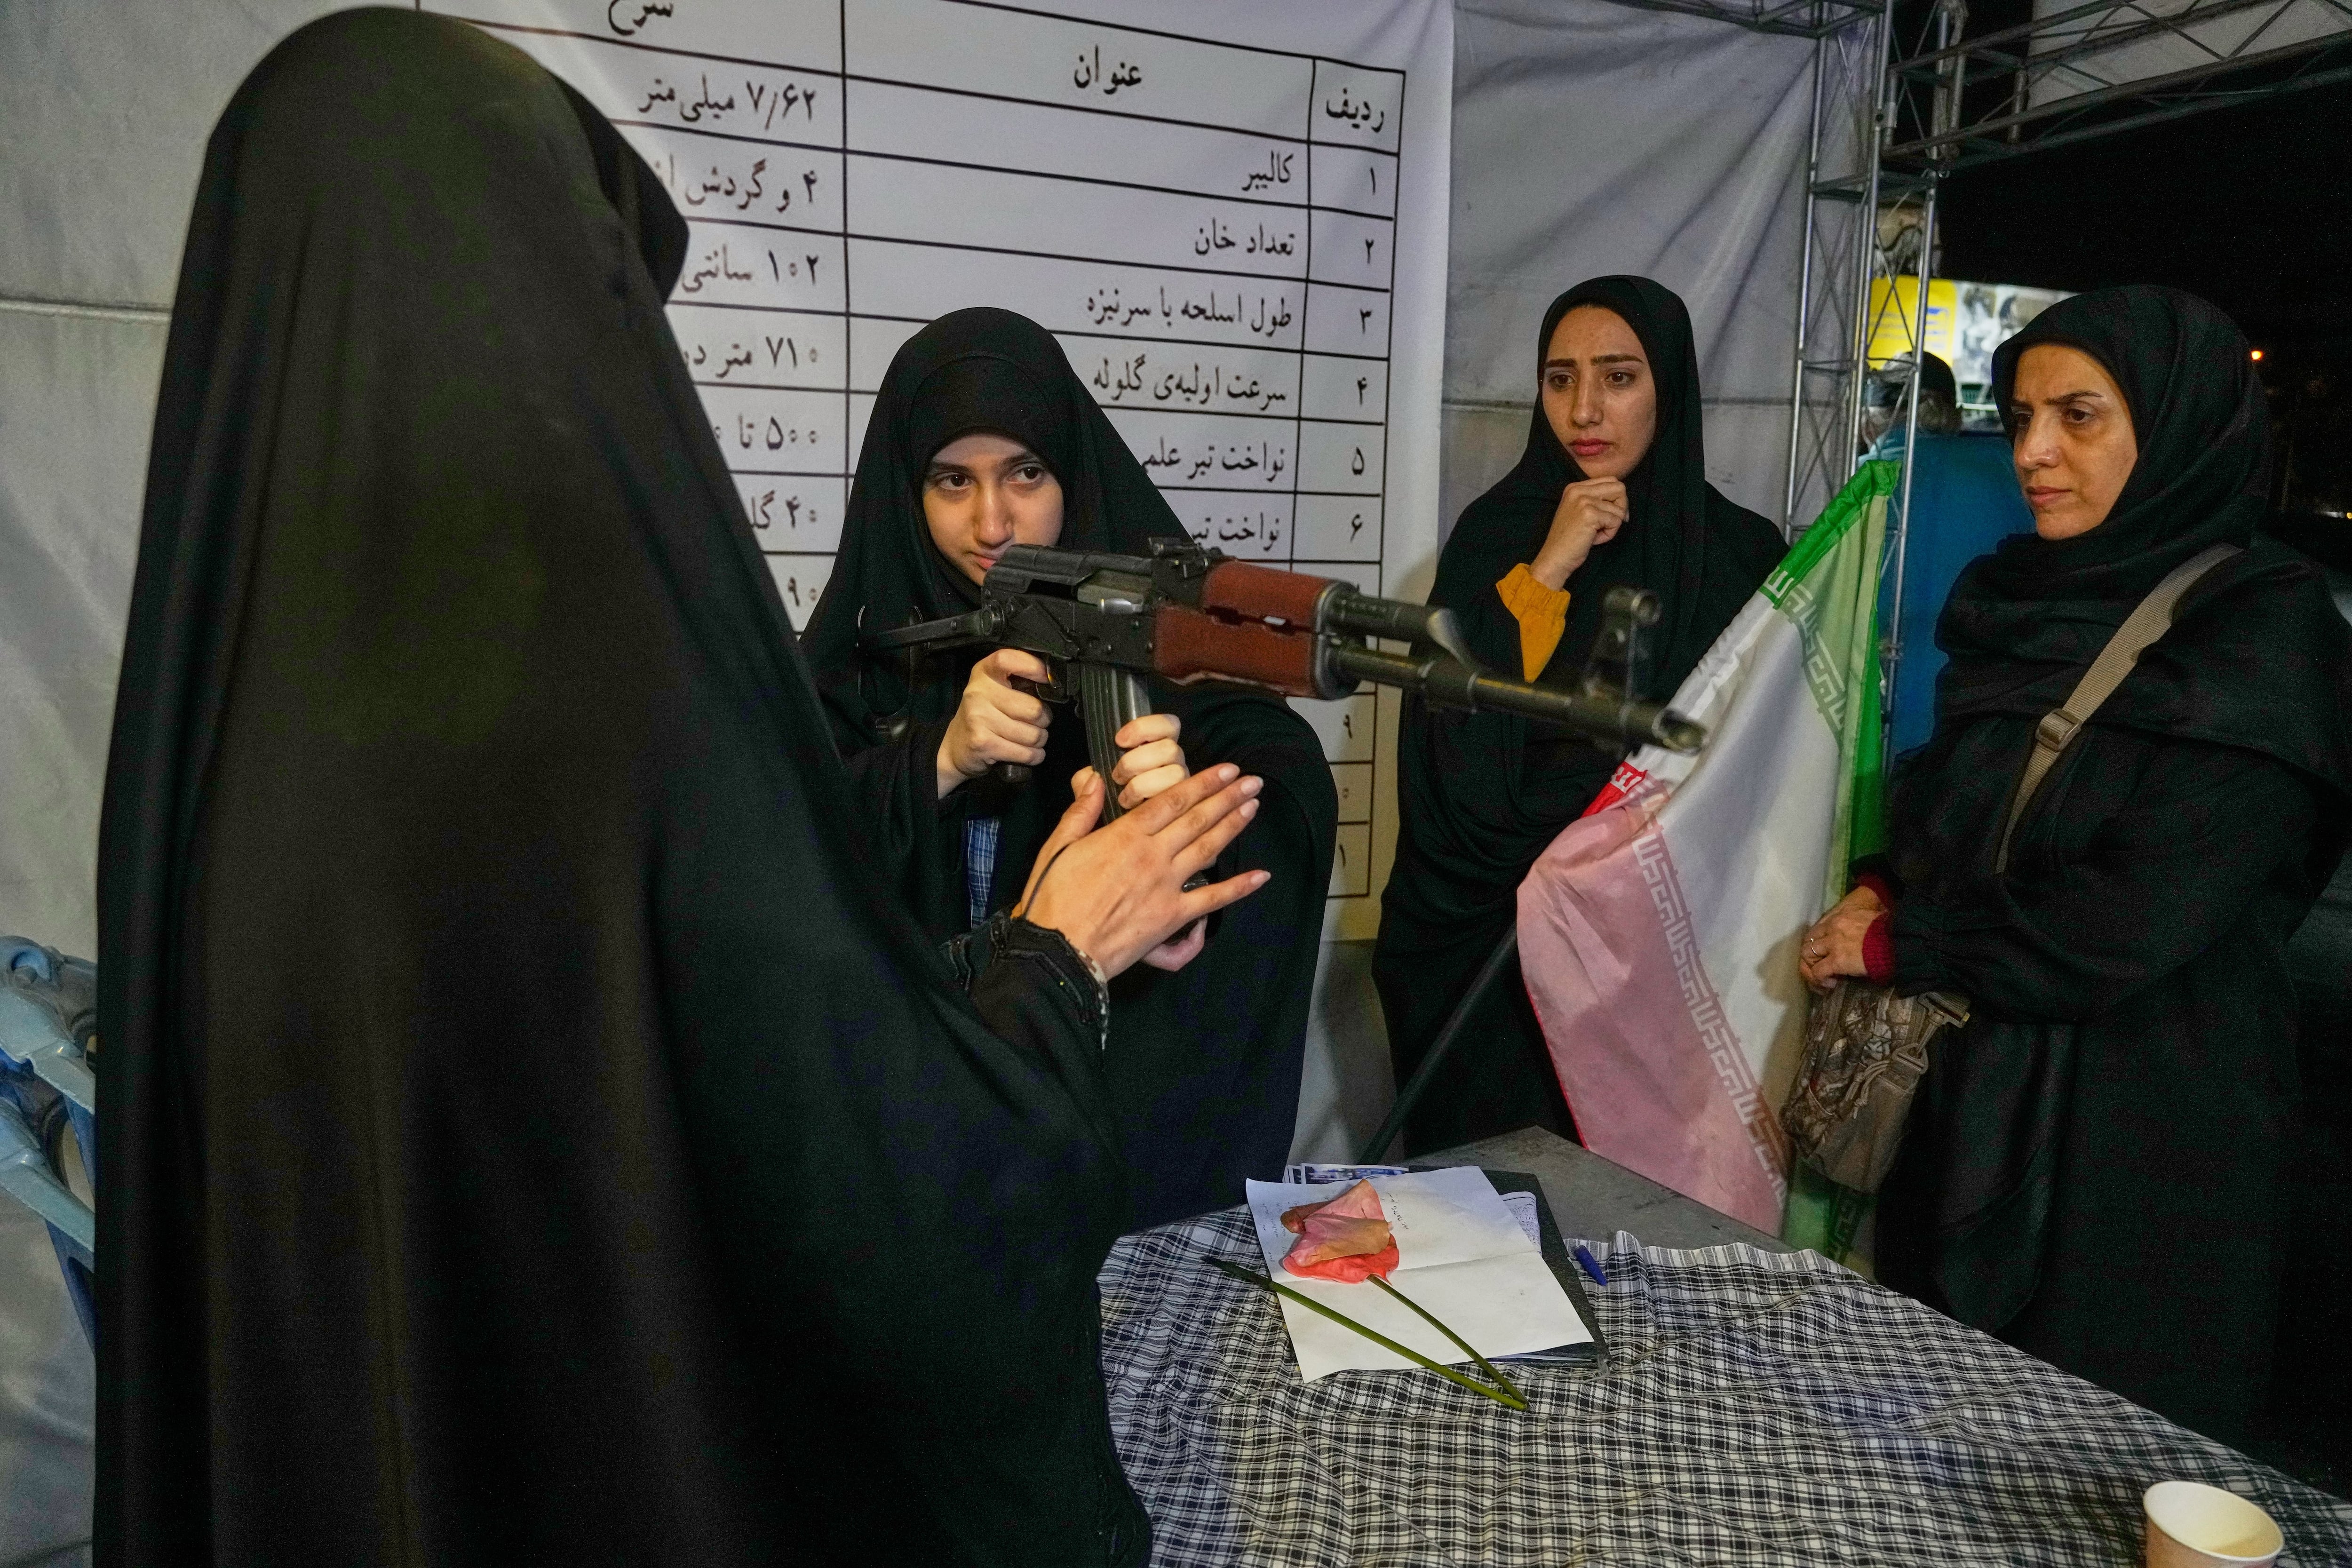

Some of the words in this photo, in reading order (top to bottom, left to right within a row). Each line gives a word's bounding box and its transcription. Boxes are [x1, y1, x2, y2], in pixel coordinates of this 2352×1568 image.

[1073, 44, 1143, 96] عنوان
[746, 80, 817, 131] ۷/۶۲
[1325, 87, 1385, 134] ردیف
[684, 158, 767, 211] گردش
[802, 169, 818, 204] ۴
[1241, 150, 1294, 192] کالیبر
[1369, 166, 1376, 196] ۱
[775, 188, 791, 214] و
[1194, 217, 1237, 256] خان
[1246, 223, 1295, 257] تعداد
[1365, 238, 1375, 265] ۲
[768, 249, 820, 286] ۱۰۲
[1160, 286, 1172, 327] با
[1180, 291, 1243, 324] اسلحه
[1250, 296, 1292, 338] طول
[1359, 308, 1373, 334] ۳
[715, 343, 753, 380] متر
[1093, 353, 1146, 402] گلوله
[1226, 374, 1287, 412] سرعت
[1357, 376, 1368, 406] ۴
[738, 414, 755, 450] تا
[1186, 445, 1216, 480] تیر
[1221, 441, 1285, 482] نواخت
[1351, 446, 1365, 476] ۵
[1215, 511, 1280, 552] نواخت
[1350, 513, 1364, 542] ۶
[1343, 714, 1353, 739] ۹
